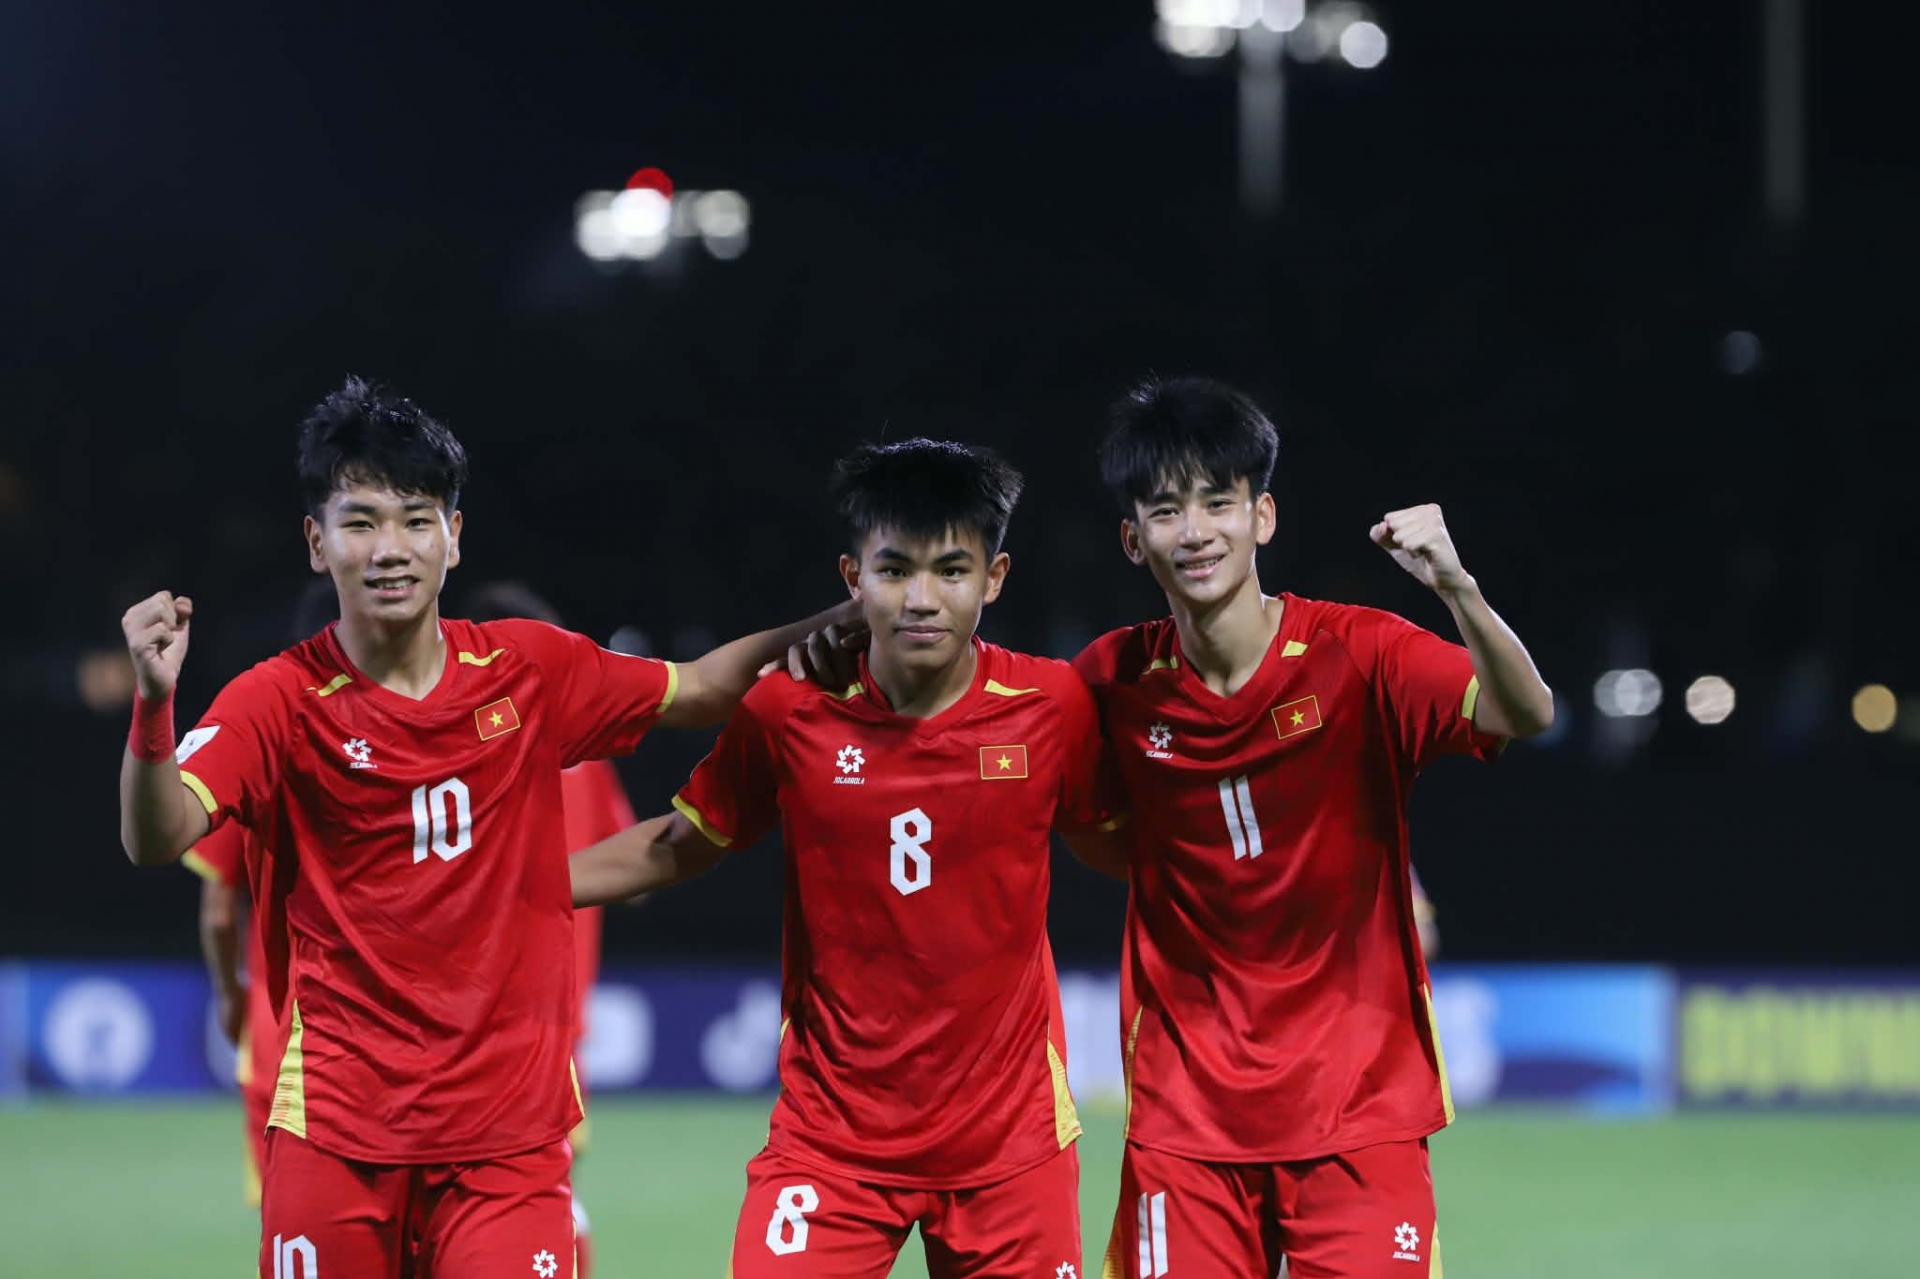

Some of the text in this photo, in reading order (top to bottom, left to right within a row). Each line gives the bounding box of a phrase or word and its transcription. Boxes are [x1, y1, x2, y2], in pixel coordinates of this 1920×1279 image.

[411, 777, 473, 865] 10
[889, 807, 932, 896] 8
[1219, 775, 1263, 861] 11
[765, 1183, 820, 1257] 8
[1138, 1191, 1169, 1279] 11
